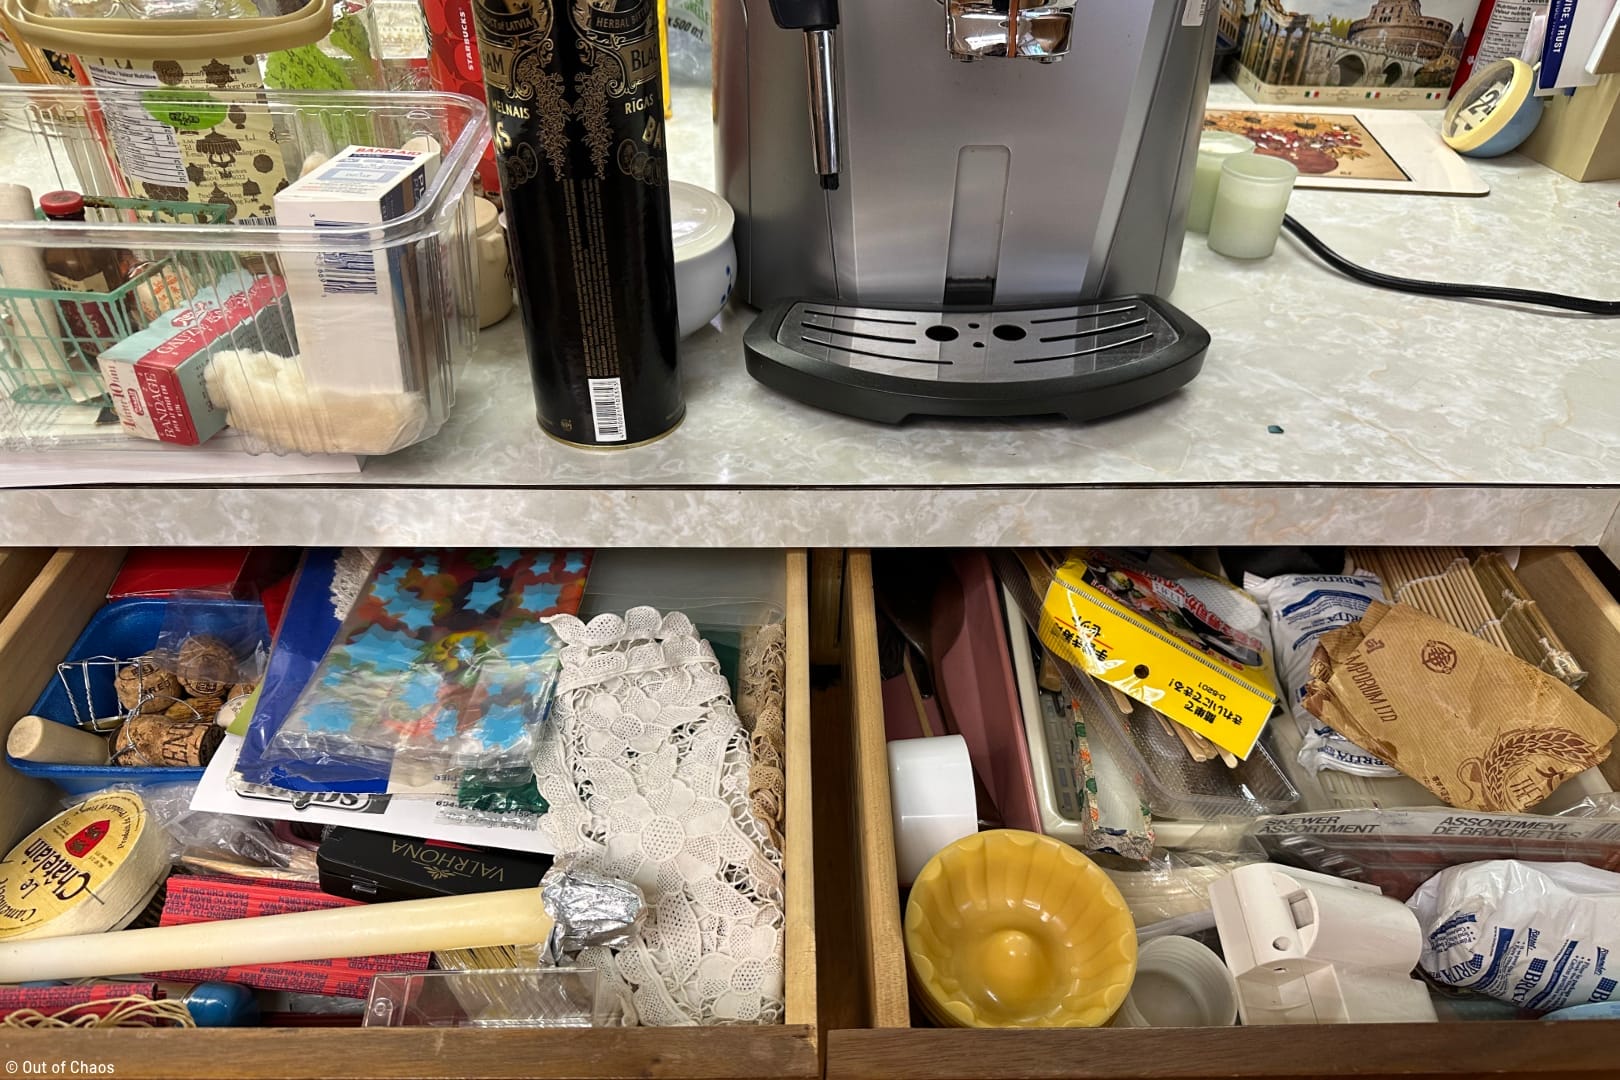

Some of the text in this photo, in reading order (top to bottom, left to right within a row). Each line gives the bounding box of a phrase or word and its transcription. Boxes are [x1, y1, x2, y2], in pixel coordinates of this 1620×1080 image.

[505, 16, 532, 31] LATVIA
[596, 16, 630, 28] HERBAL
[673, 15, 692, 33] 500
[459, 11, 474, 71] STARBUCKS
[1553, 24, 1567, 53] TRUST
[355, 147, 422, 156] BAND-AID
[144, 373, 177, 438] BANDAGE
[1374, 699, 1398, 724] LTD
[1264, 815, 1340, 825] SKEWER
[1439, 816, 1570, 831] ASSORTIMENT
[1256, 823, 1380, 834] ASSORTMENT
[1432, 826, 1582, 840] DE BROCHETTES
[391, 838, 506, 882] VALRHONA
[23, 836, 92, 901] Châtelain
[20, 878, 39, 900] Le
[182, 886, 250, 900] FROM CHILDREN
[214, 898, 250, 908] PLASTIC
[278, 895, 321, 907] CHILDREN
[165, 906, 191, 916] AVOID
[259, 966, 329, 981] FROM CHILDREN
